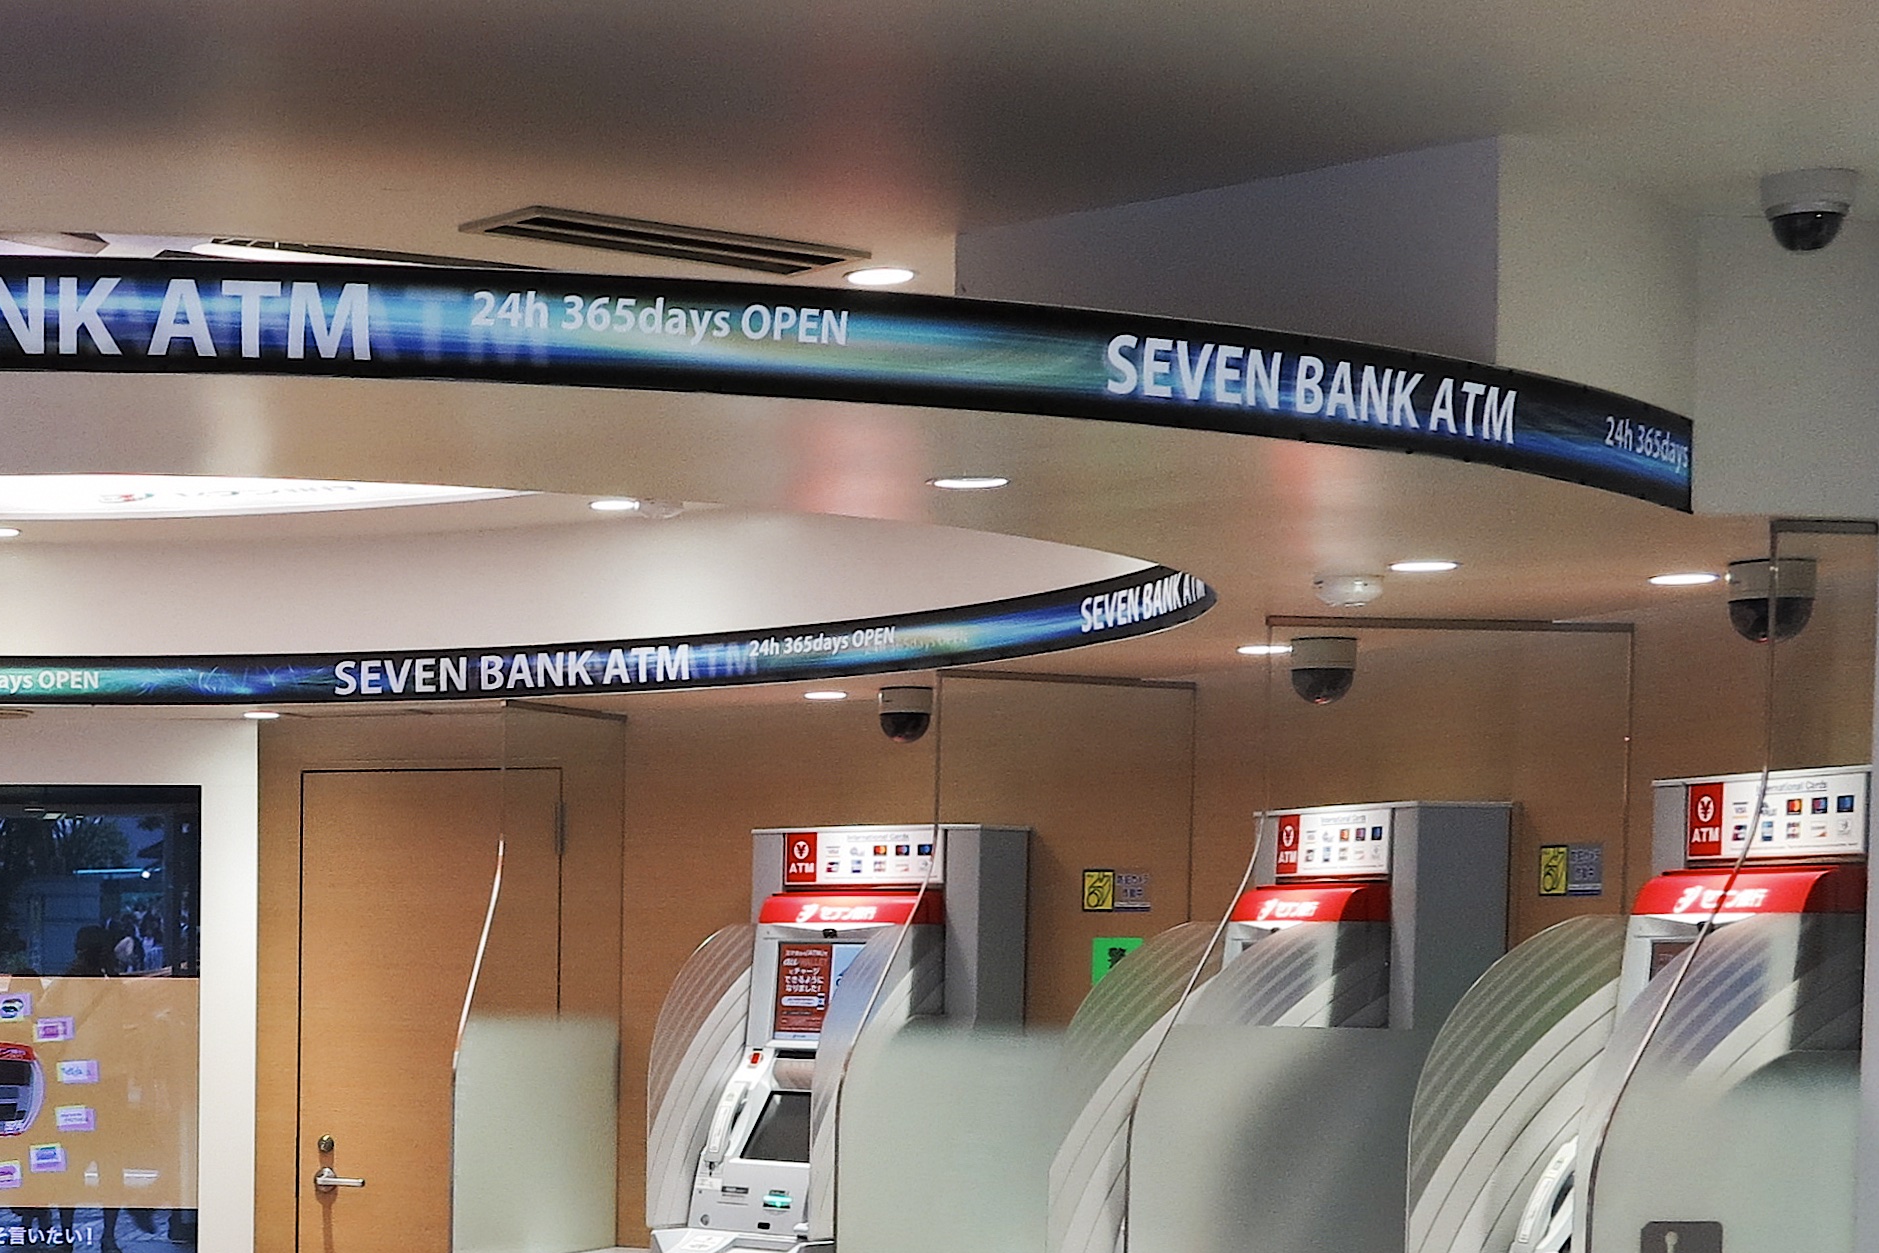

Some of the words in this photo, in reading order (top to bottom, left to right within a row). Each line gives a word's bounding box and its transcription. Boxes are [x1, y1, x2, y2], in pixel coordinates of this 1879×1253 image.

[145, 277, 373, 361] ATM
[470, 290, 550, 330] 24h
[562, 296, 731, 347] 365days
[740, 303, 850, 346] OPEN
[1106, 333, 1283, 410] SEVEN
[1295, 355, 1424, 430] BANK
[1430, 376, 1518, 445] ATM
[1604, 414, 1632, 452] 24h
[1080, 586, 1141, 633] SEVEN
[1142, 571, 1183, 621] BANK
[749, 637, 780, 658] 24h
[784, 631, 849, 656] 365days
[852, 626, 896, 648] OPEN
[38, 669, 100, 692] OPEN
[334, 657, 468, 697] SEVEN
[480, 650, 593, 691] BANK
[602, 643, 691, 685] ATM
[1690, 826, 1720, 844] ATM
[789, 862, 815, 874] ATM
[1278, 850, 1298, 864] ATM
